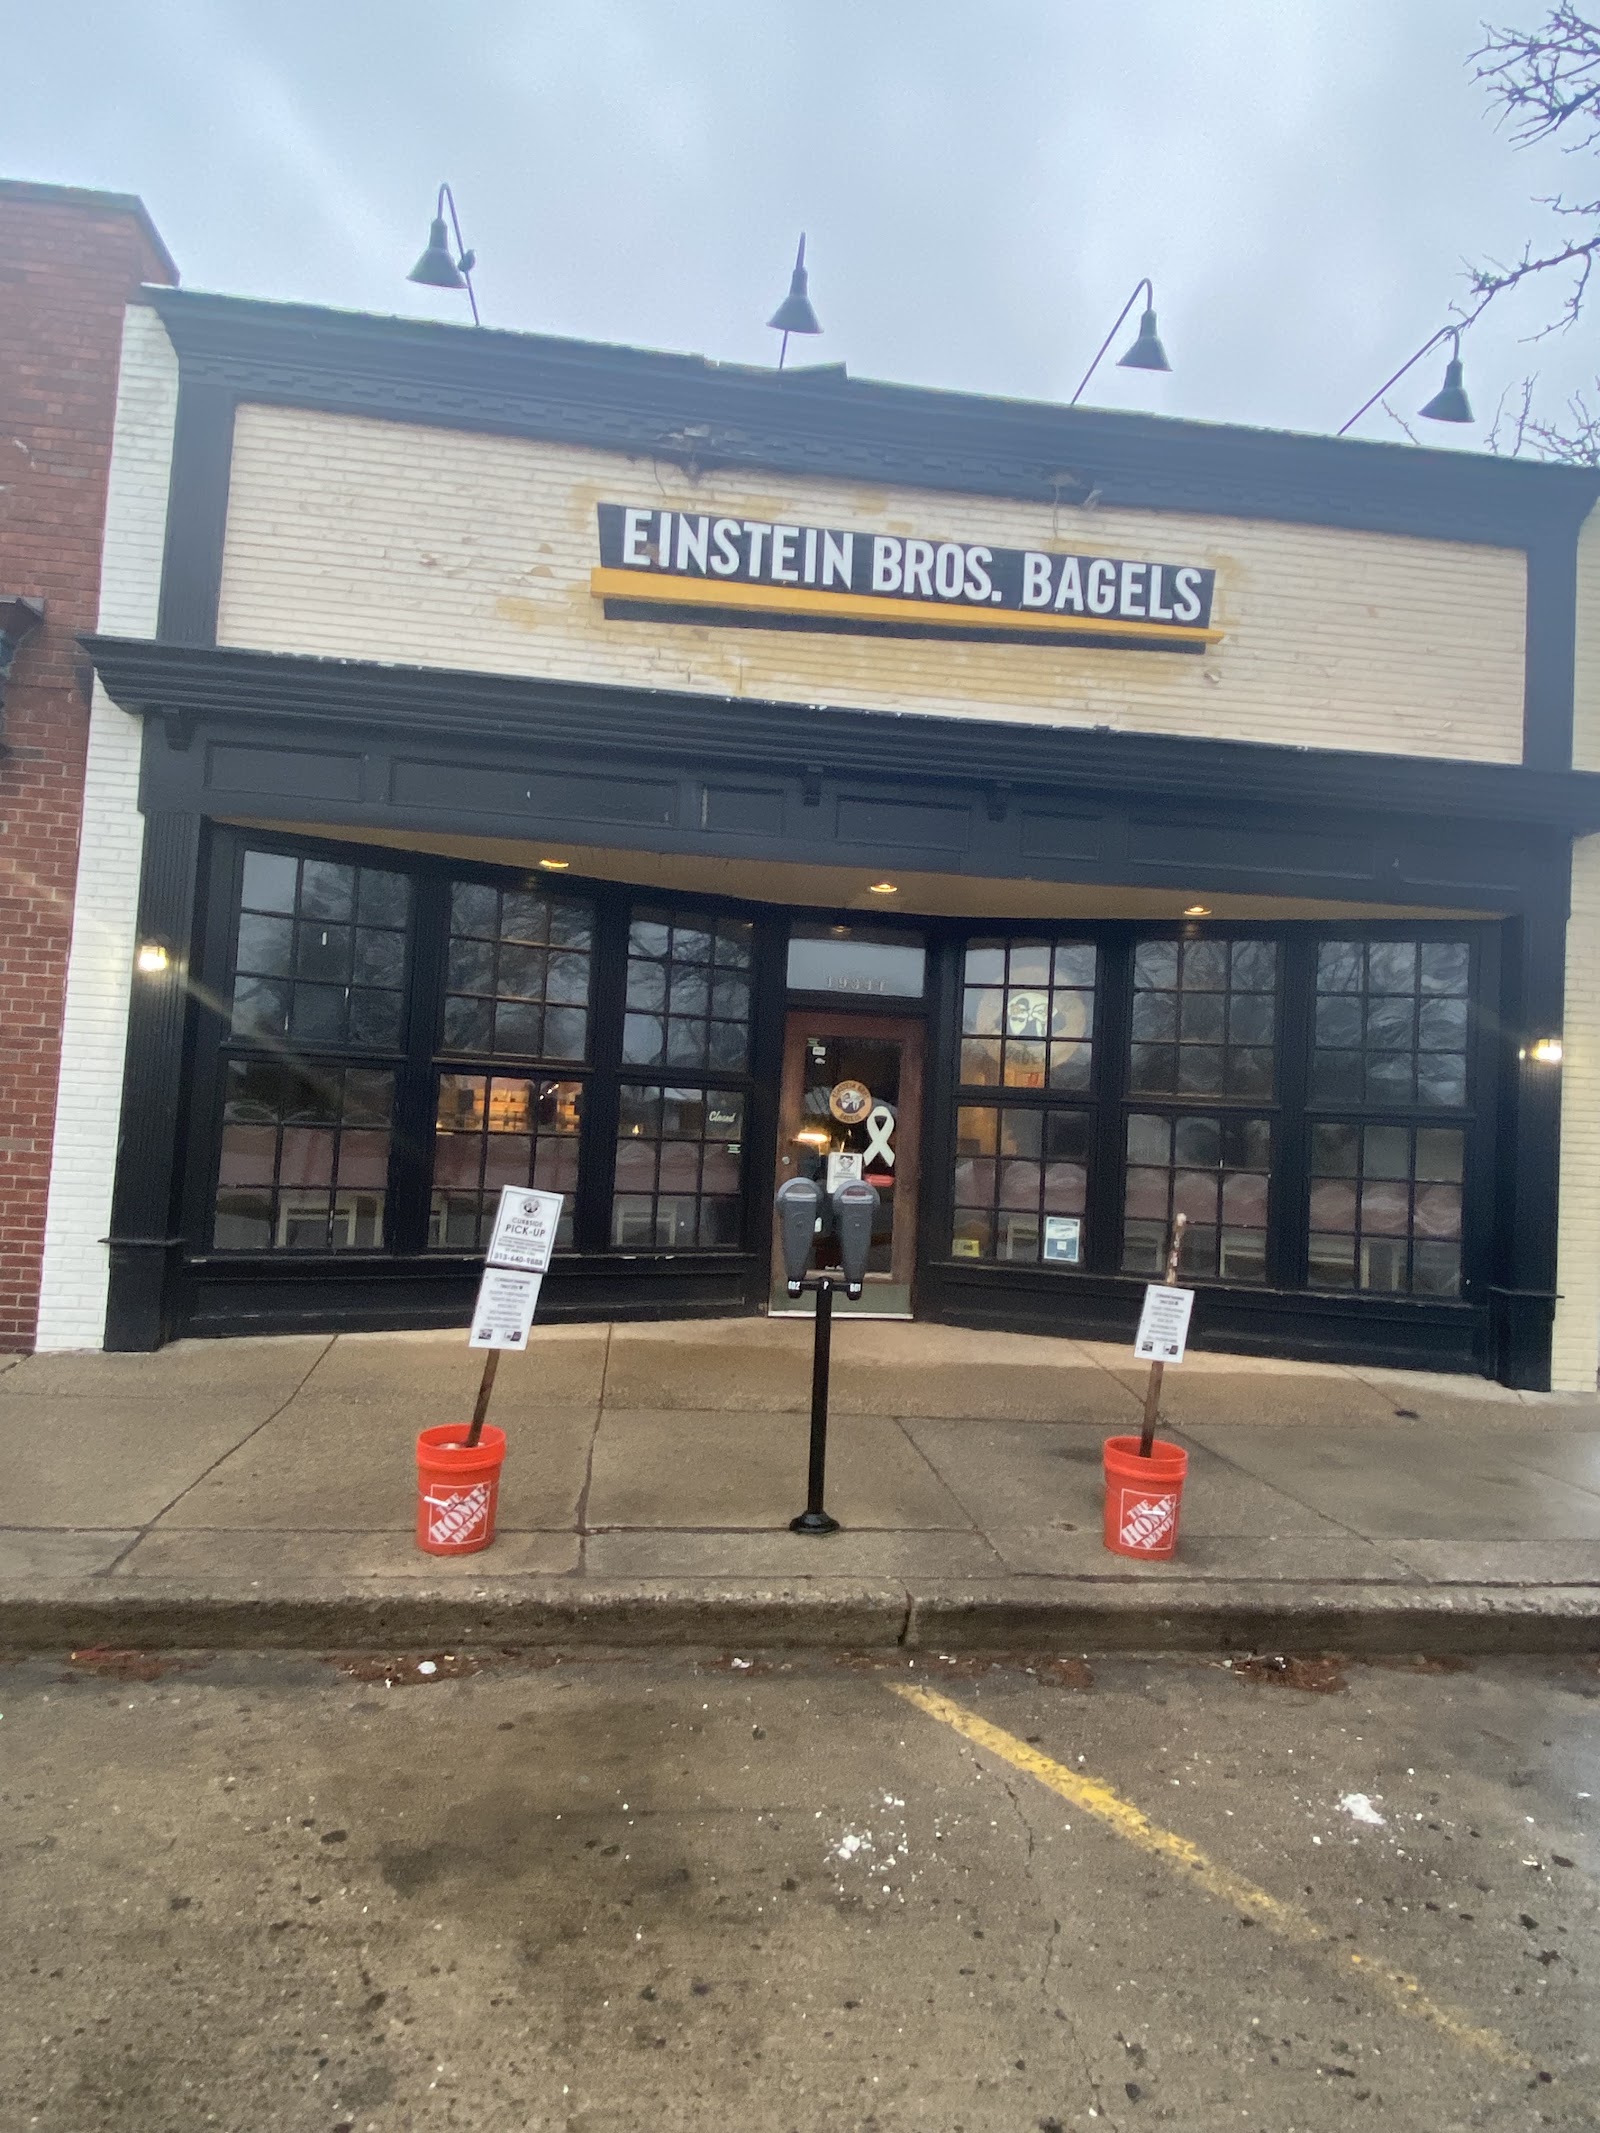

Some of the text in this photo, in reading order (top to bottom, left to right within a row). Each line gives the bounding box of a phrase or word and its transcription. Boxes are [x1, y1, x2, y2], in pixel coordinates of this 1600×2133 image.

[623, 508, 1202, 621] EINSTEIN BROS. BAGELS
[505, 1224, 546, 1237] PICK-UP
[511, 1217, 543, 1227] CURBSIDE
[430, 1483, 489, 1543] HOME
[1121, 1494, 1174, 1546] HOME
